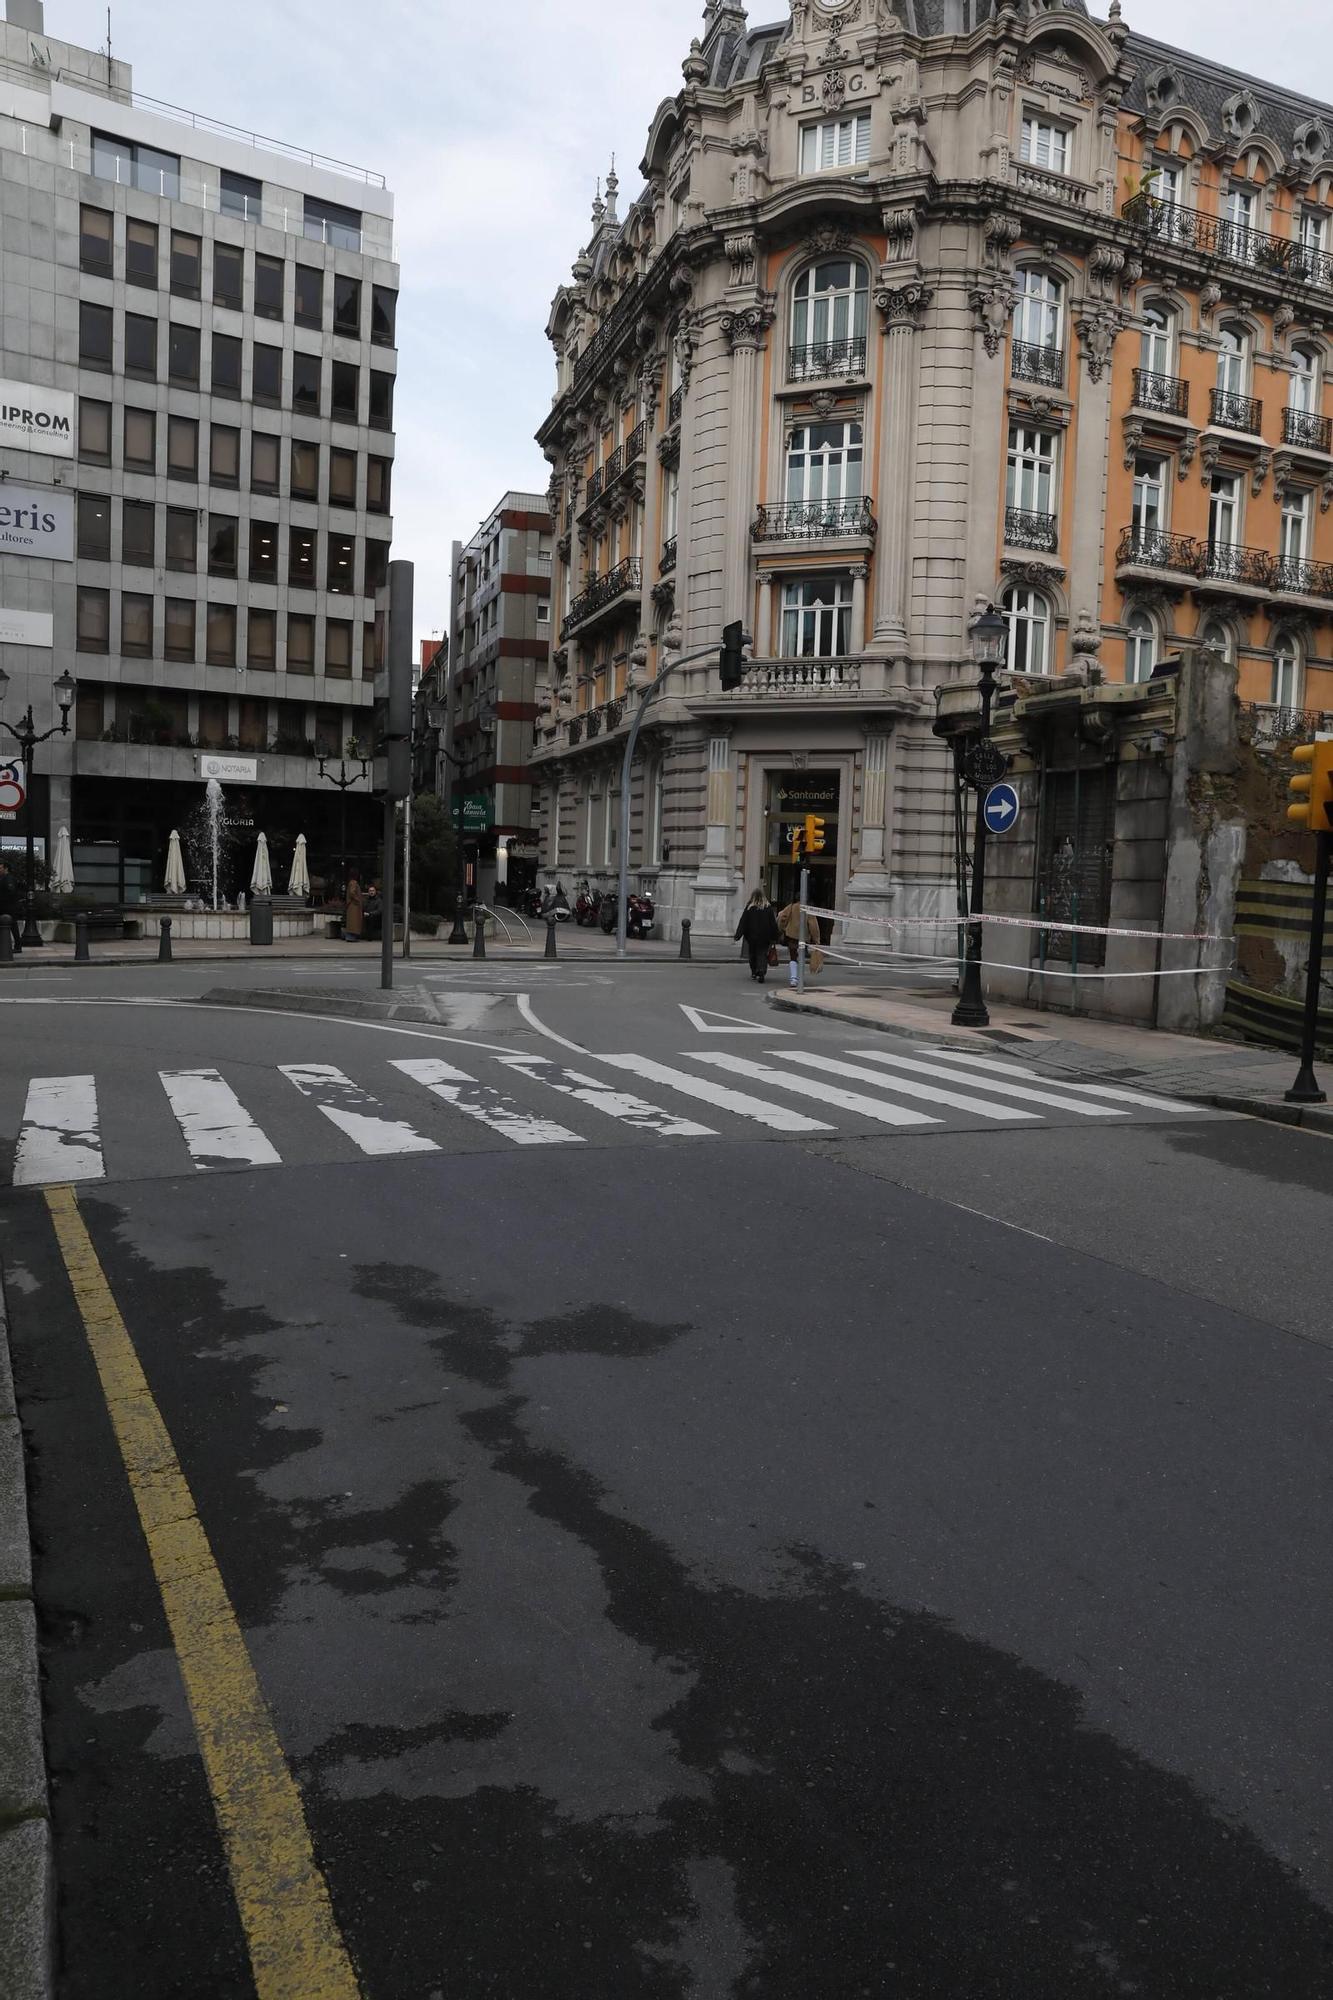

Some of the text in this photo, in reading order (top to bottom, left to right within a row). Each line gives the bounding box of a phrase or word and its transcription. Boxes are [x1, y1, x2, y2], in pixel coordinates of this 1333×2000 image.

[2, 405, 70, 432] IPROM
[0, 503, 56, 533] eris
[788, 790, 835, 800] Santander
[223, 817, 254, 826] GLORIA
